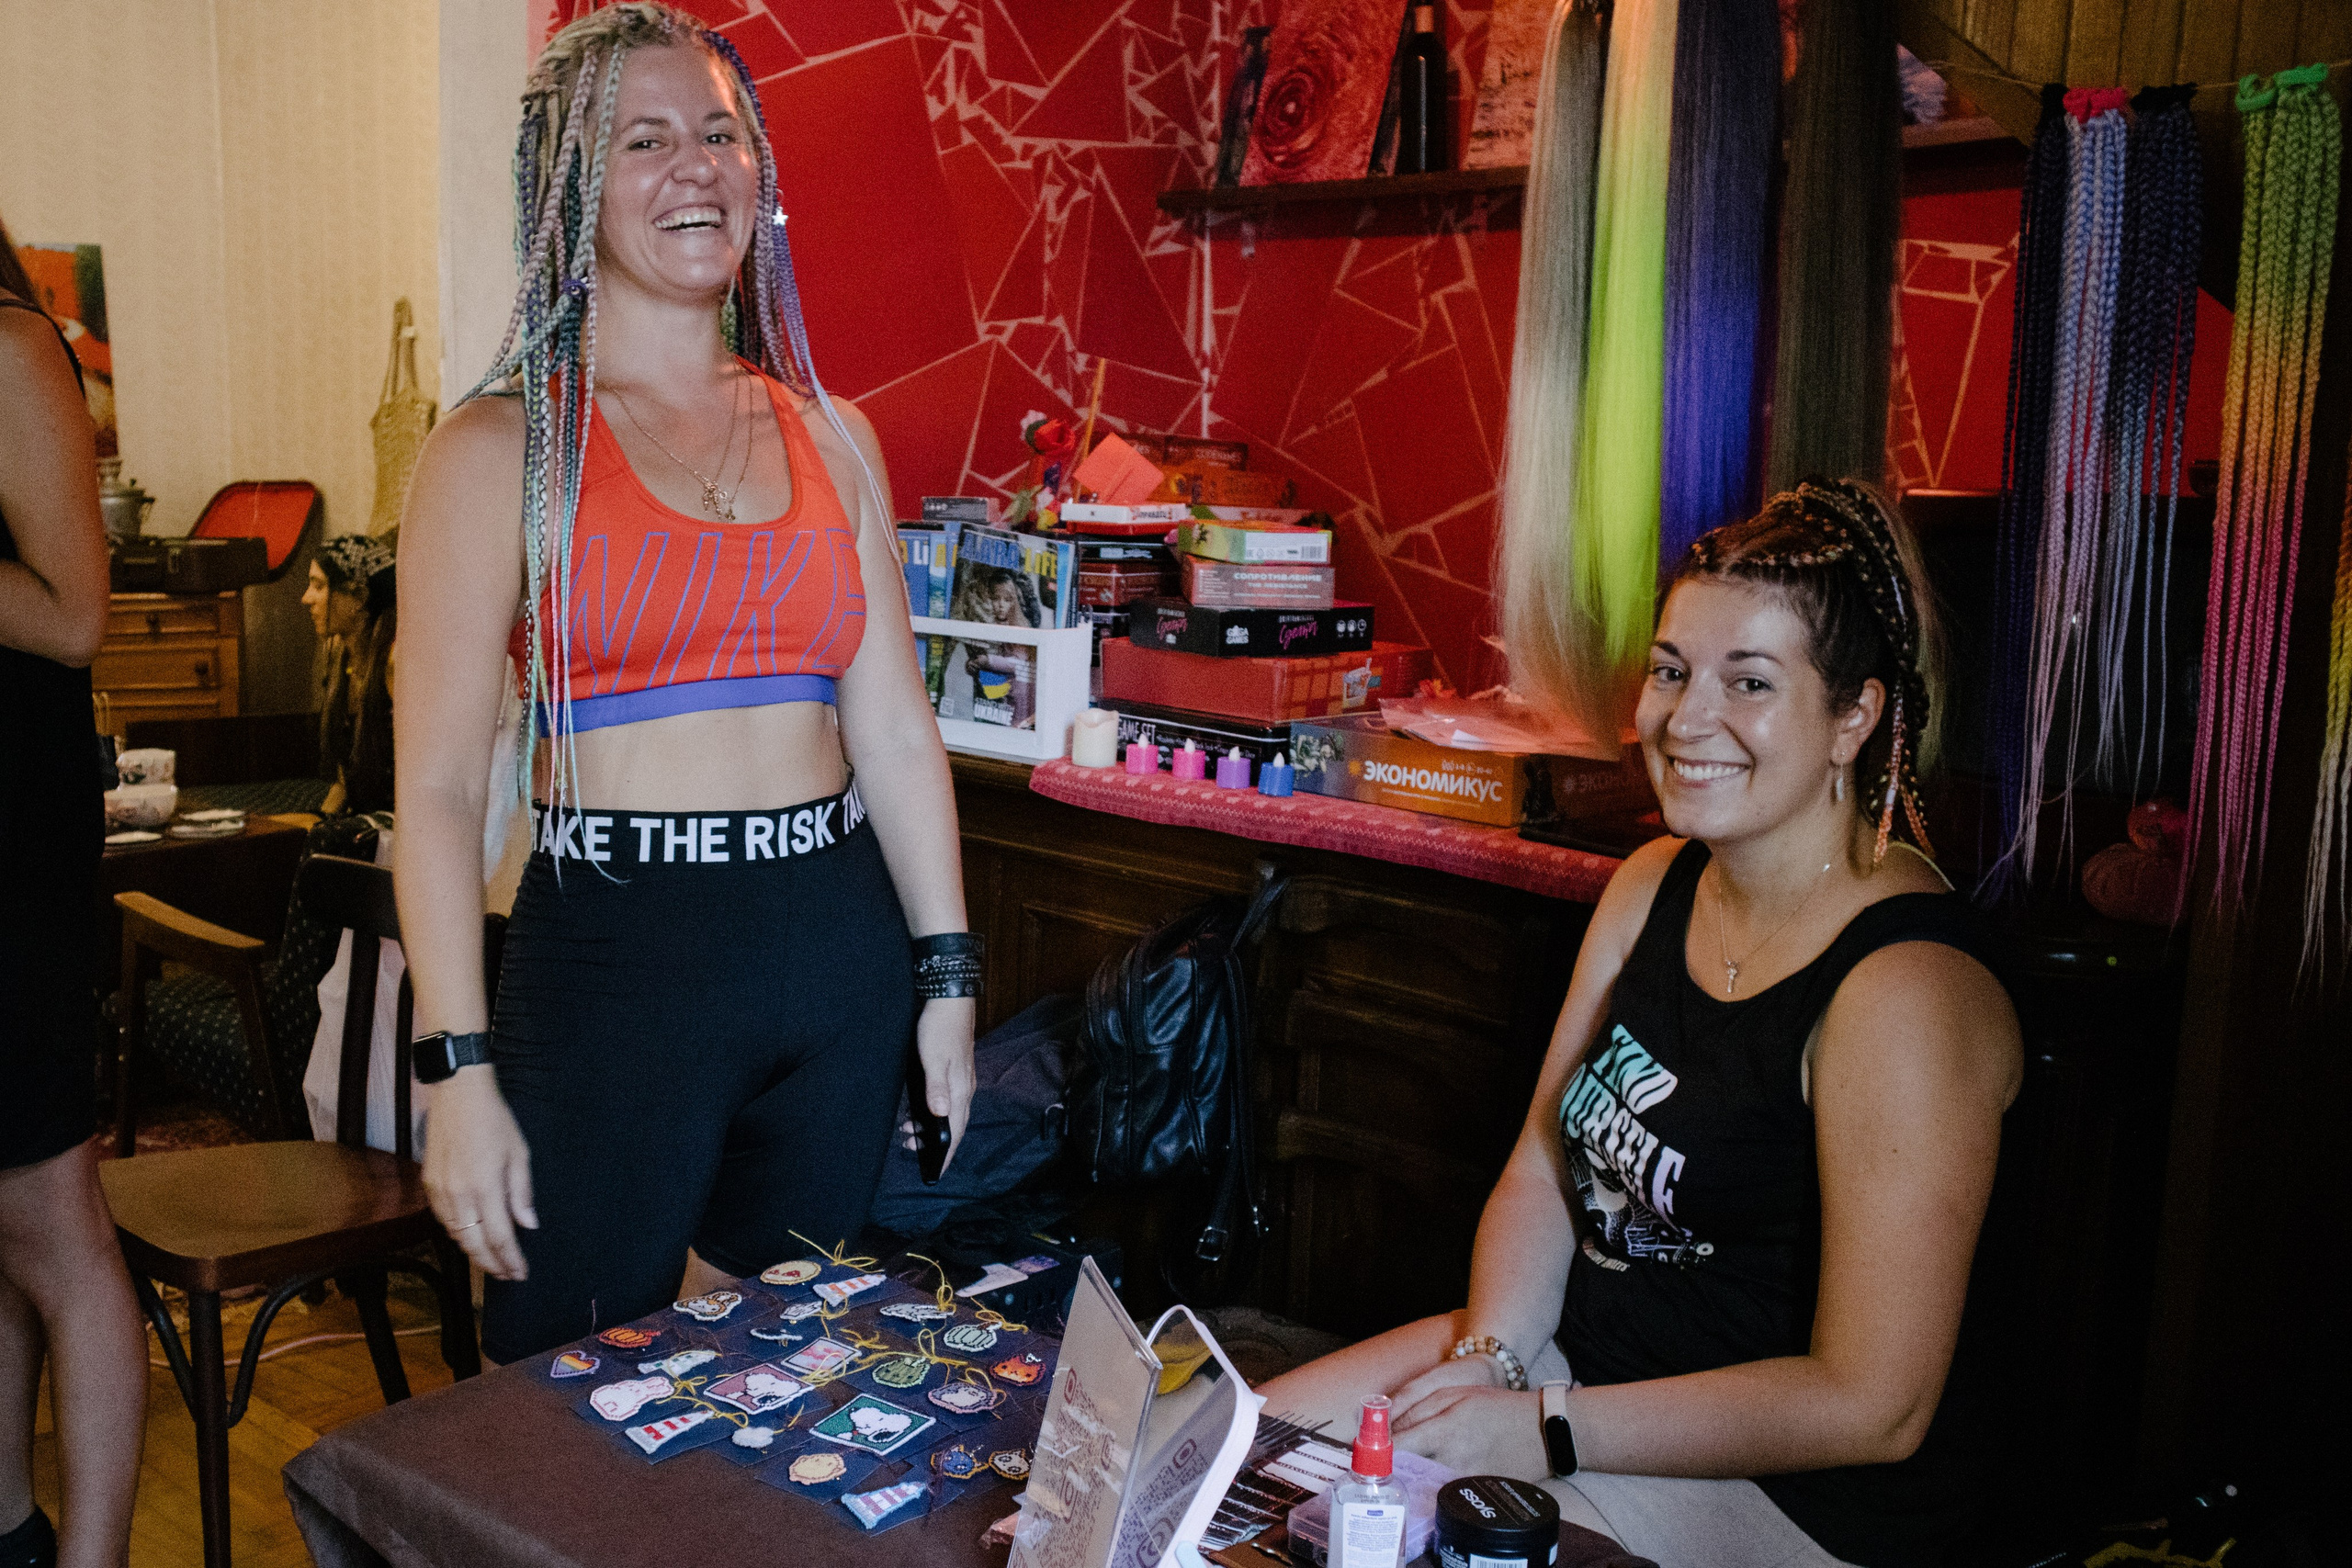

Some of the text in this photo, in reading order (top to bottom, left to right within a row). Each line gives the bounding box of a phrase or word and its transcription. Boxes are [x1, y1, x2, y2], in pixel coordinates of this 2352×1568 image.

[1233, 572, 1322, 582] СОПРОТИВЛЕНИЕ
[555, 527, 865, 696] NIKE
[974, 704, 1014, 727] UKRAINE
[1363, 759, 1504, 803] ЭКОНОМИКУС
[531, 781, 866, 863] TAKE THE RISK TAK
[1459, 1487, 1497, 1520] syoss
